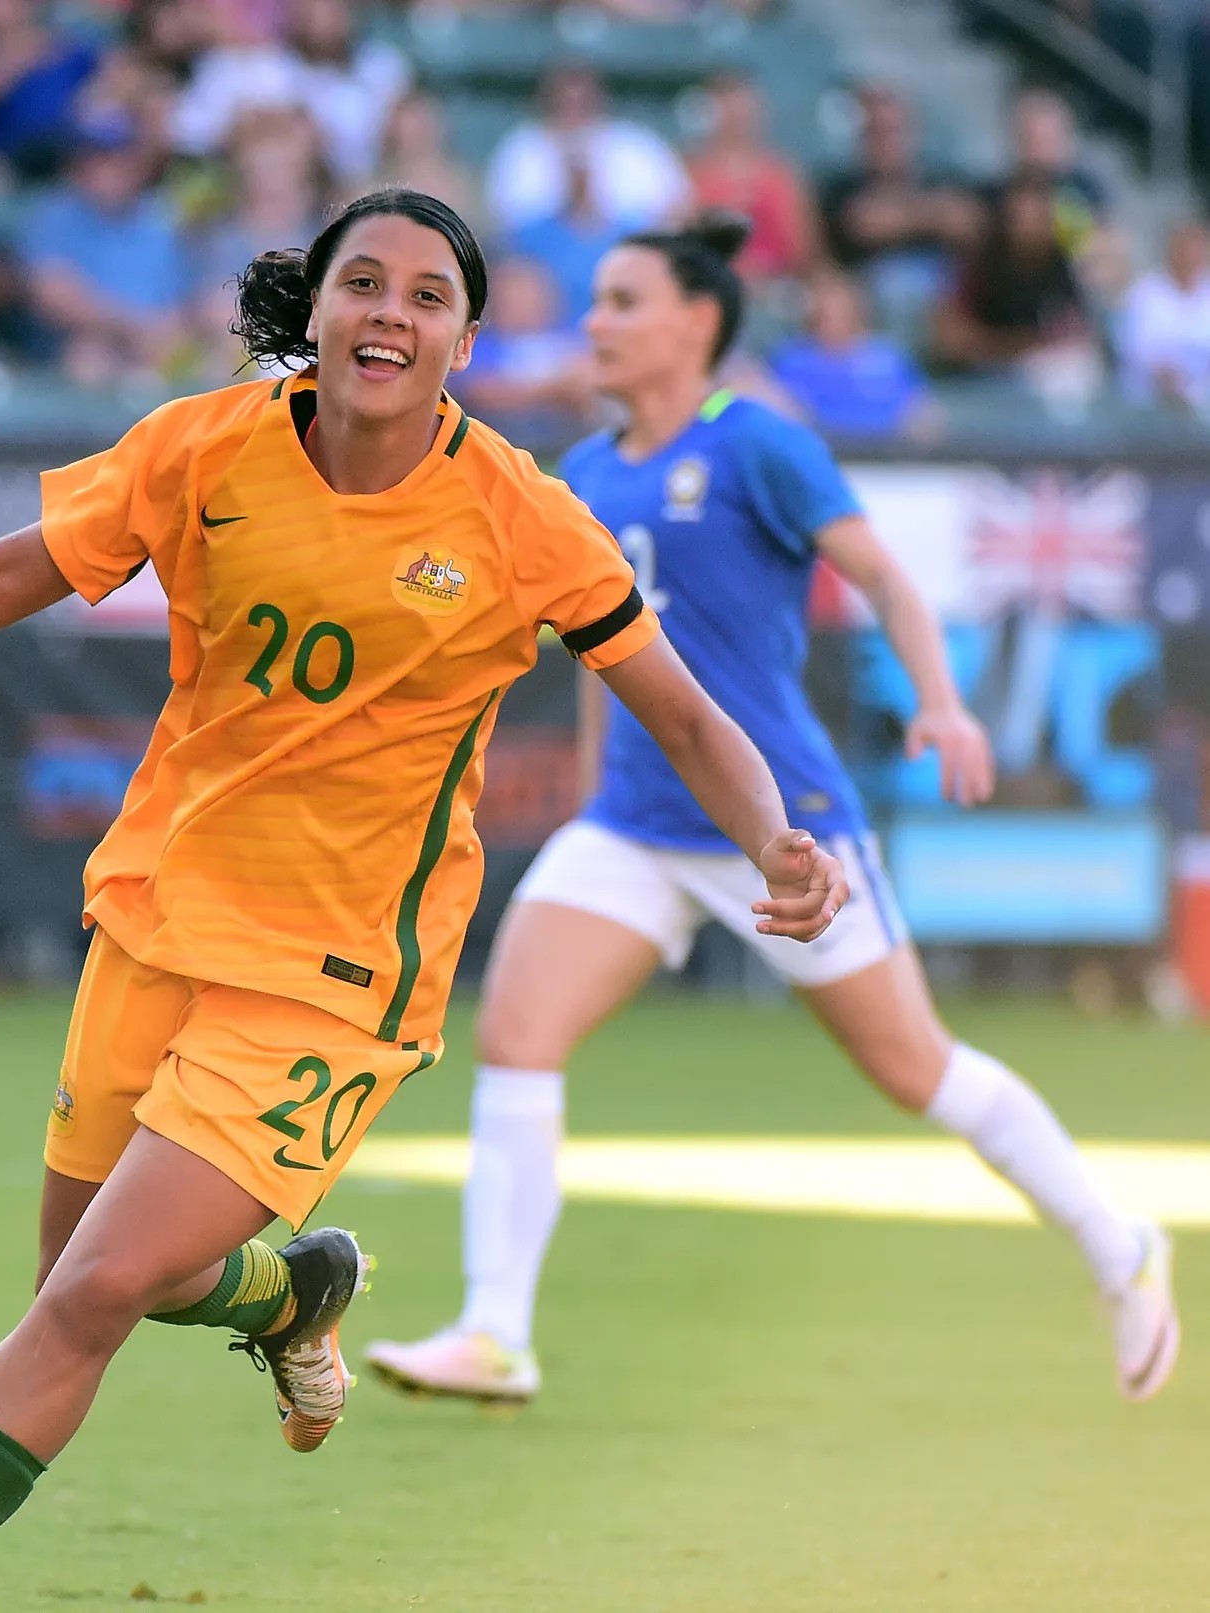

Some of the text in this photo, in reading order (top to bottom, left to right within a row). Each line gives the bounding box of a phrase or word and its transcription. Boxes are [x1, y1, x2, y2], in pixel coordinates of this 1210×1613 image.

[404, 584, 454, 601] AUSTRALIA
[244, 603, 355, 704] 20
[256, 1055, 378, 1162] 20
